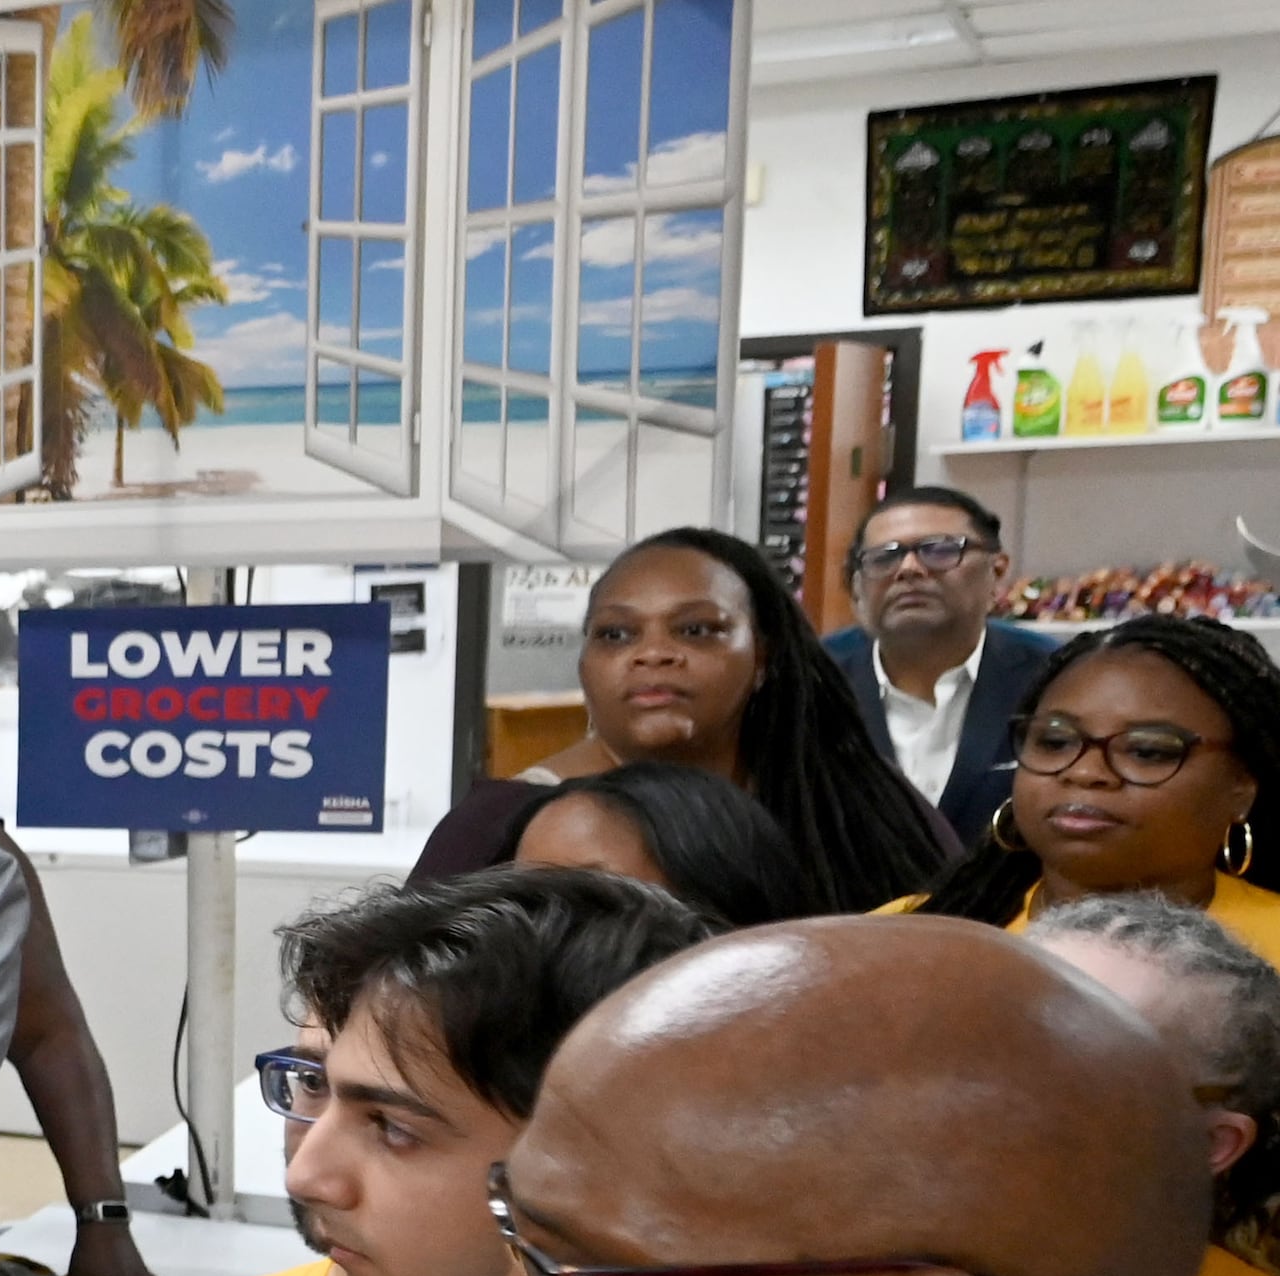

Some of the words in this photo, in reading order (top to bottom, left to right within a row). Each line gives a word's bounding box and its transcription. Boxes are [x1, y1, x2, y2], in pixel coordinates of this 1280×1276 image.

[70, 628, 333, 679] LOWER
[73, 686, 329, 722] GROCERY
[84, 730, 315, 779] COSTS
